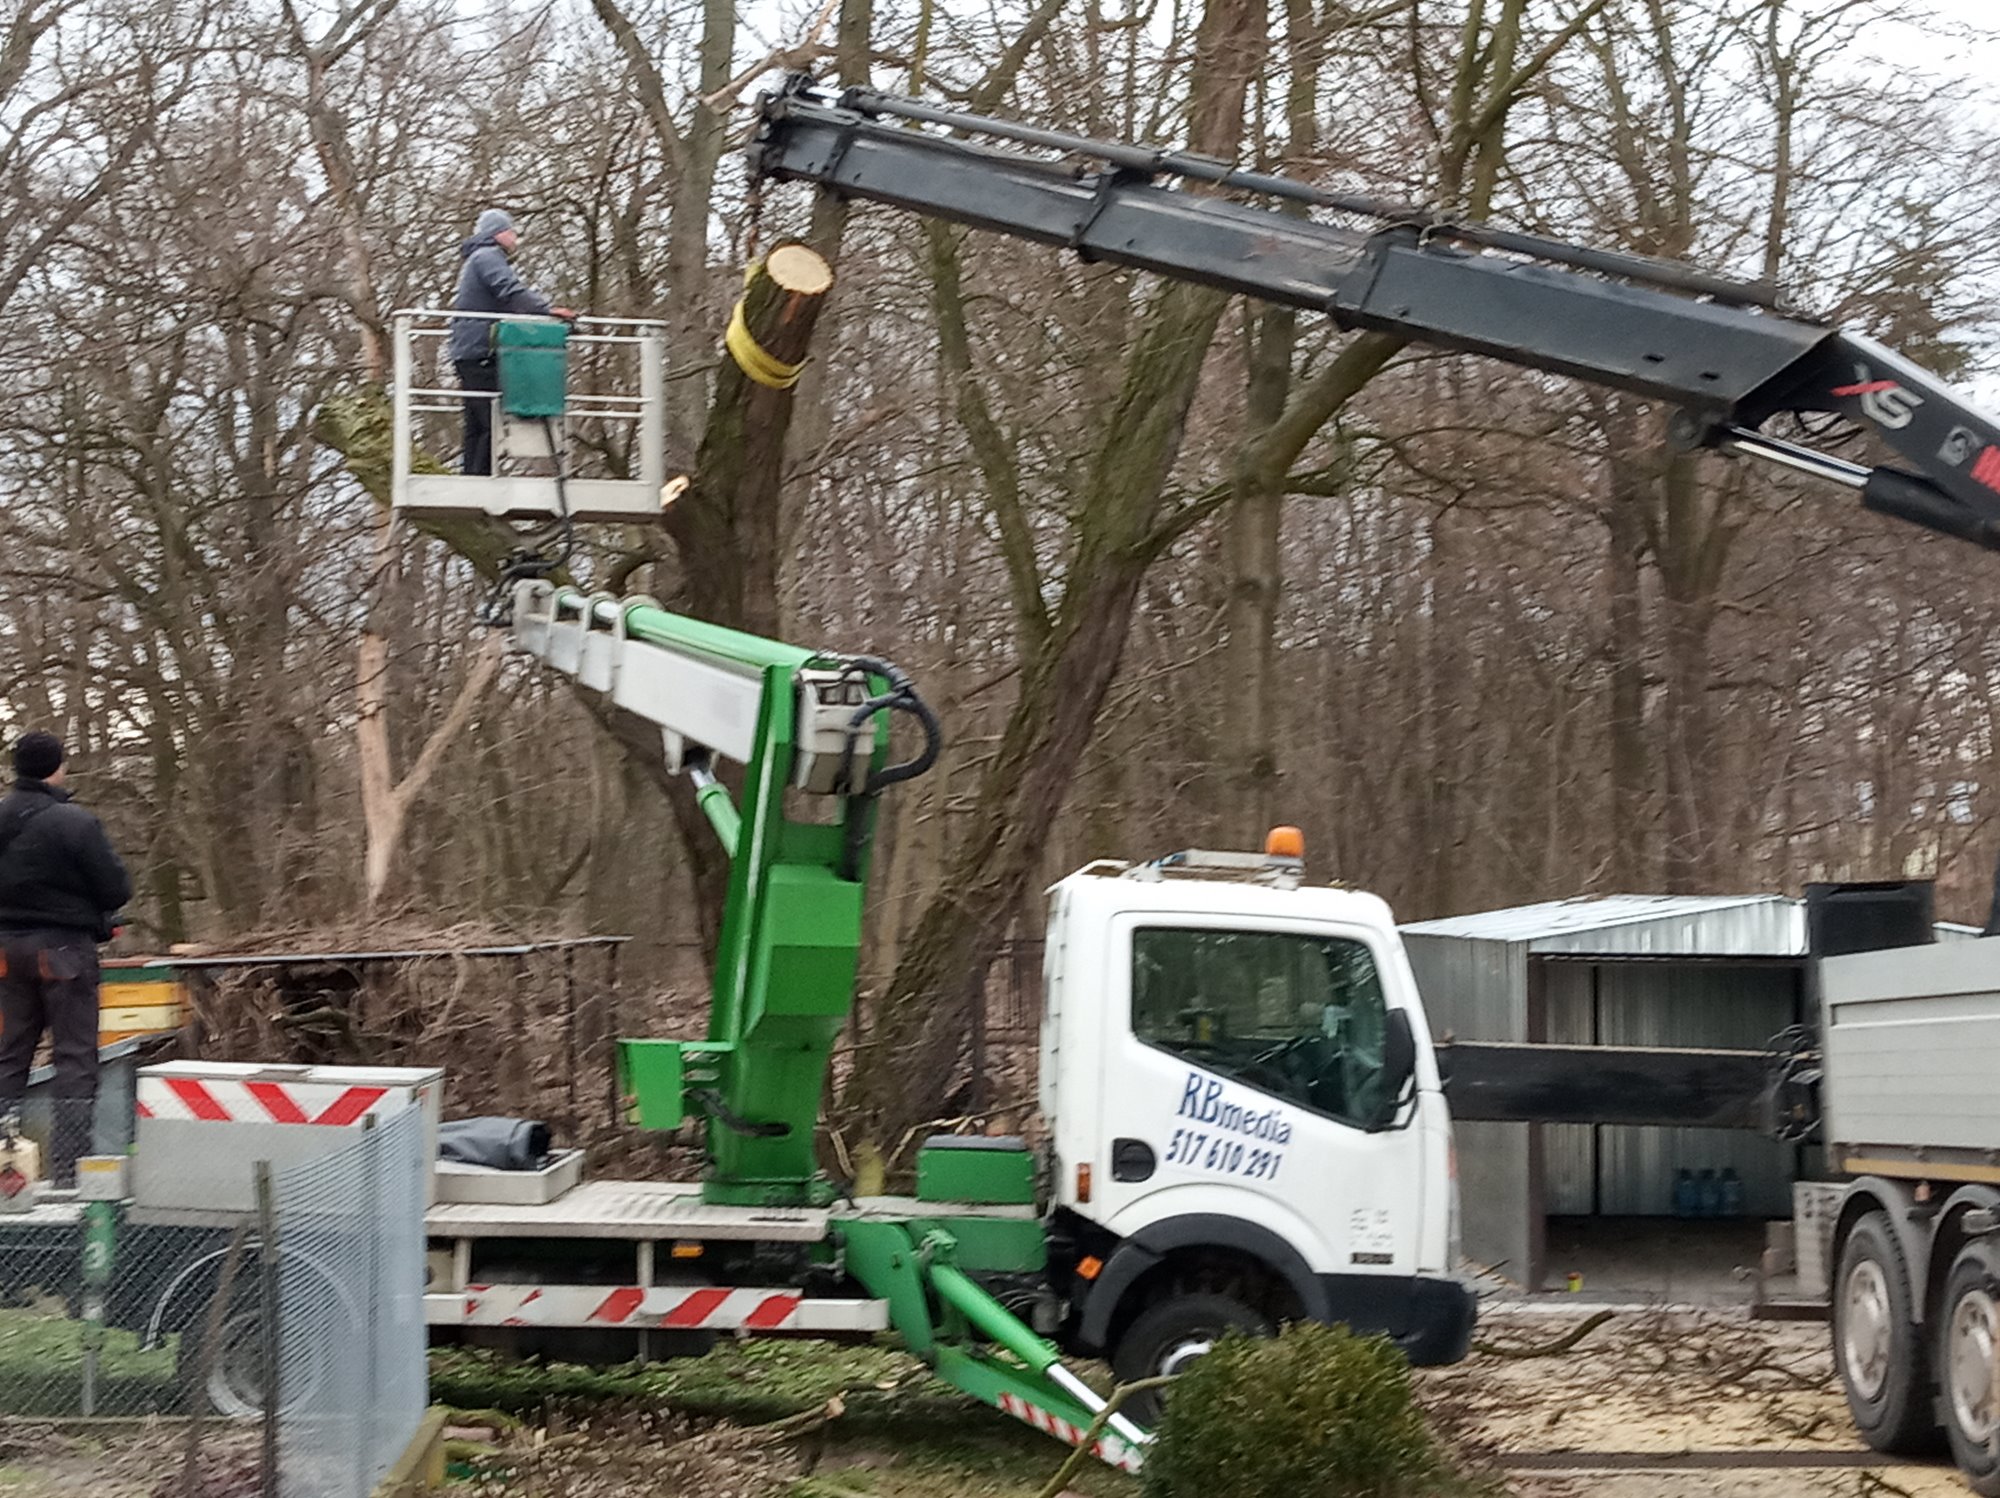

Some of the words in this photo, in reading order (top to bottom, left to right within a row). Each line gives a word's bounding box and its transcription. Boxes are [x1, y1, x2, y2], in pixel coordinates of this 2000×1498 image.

[1177, 1072, 1292, 1144] RBmedia
[1165, 1128, 1209, 1165] 517
[1204, 1138, 1245, 1173] 610
[1242, 1148, 1283, 1180] 291
